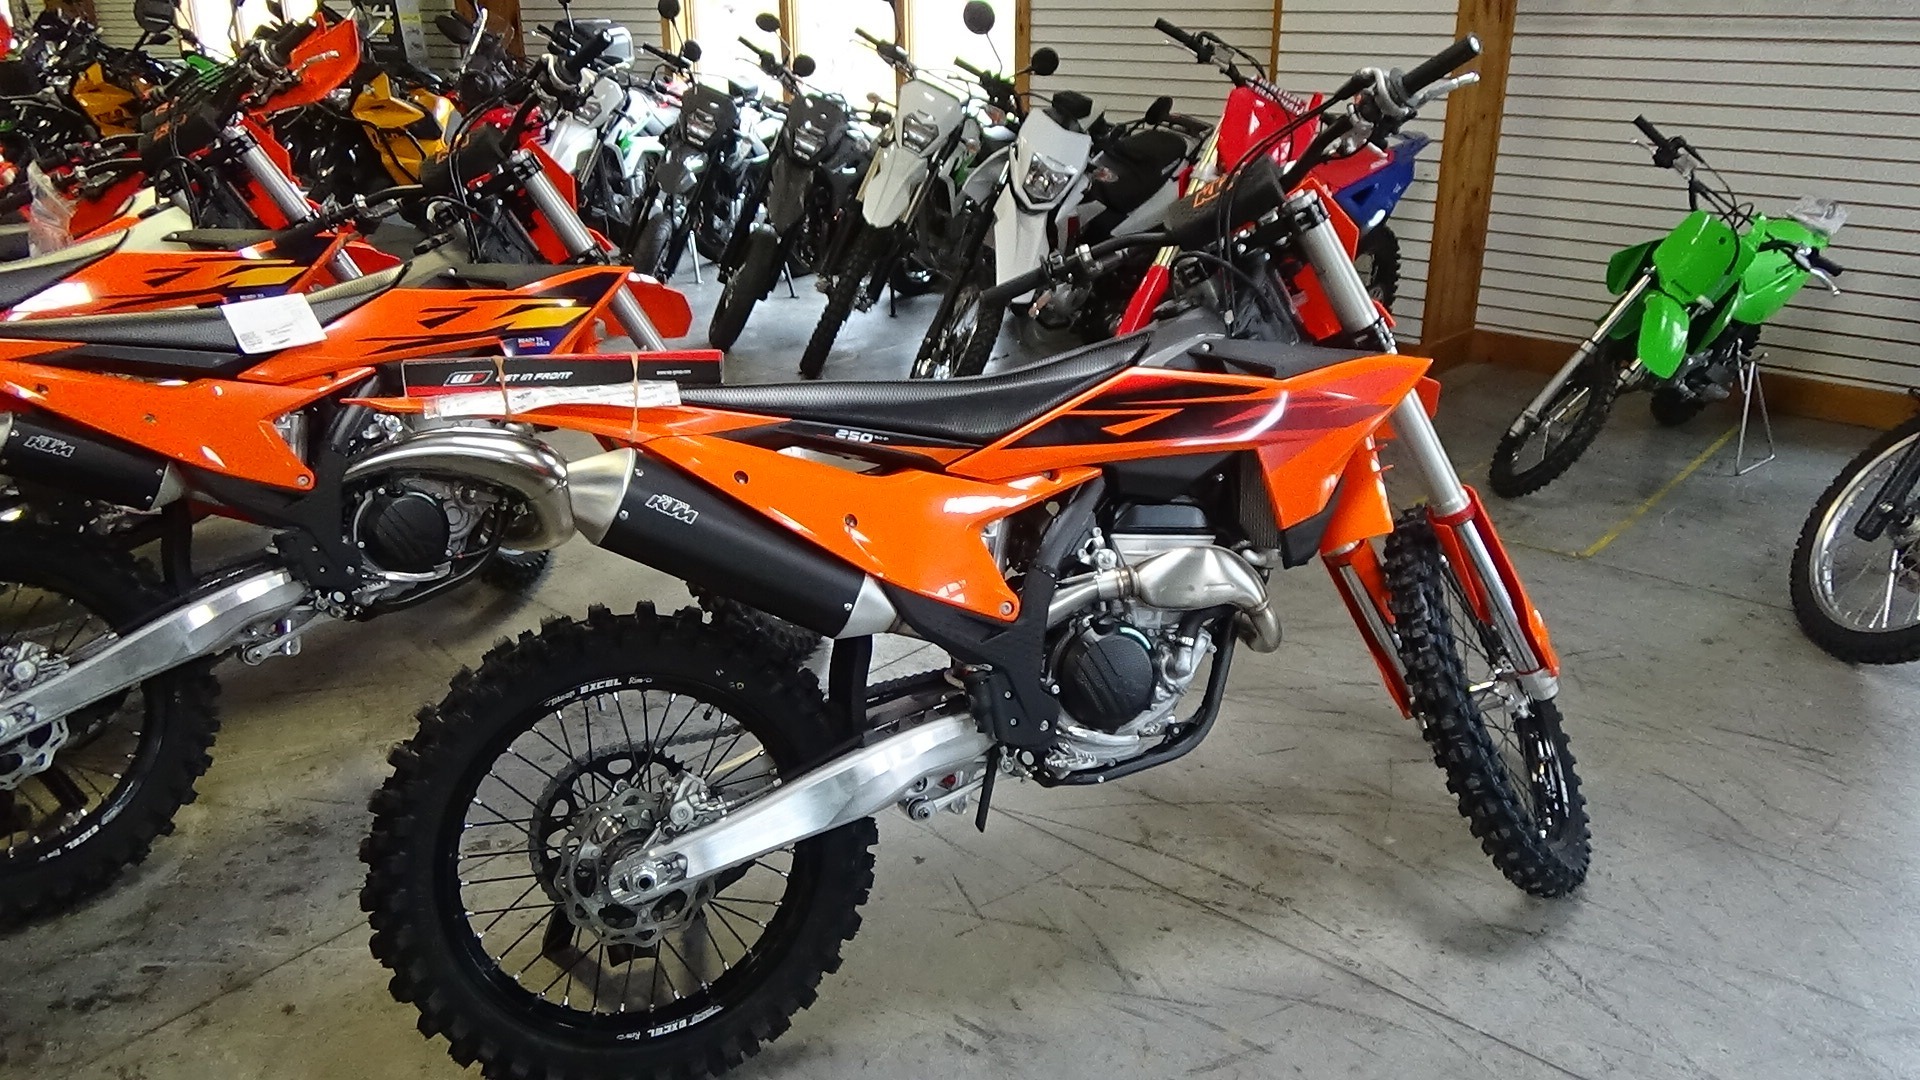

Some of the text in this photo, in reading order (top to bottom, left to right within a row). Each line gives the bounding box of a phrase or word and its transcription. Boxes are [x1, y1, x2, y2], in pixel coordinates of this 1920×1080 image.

[835, 428, 874, 443] 250
[23, 434, 76, 458] KTM
[644, 493, 700, 525] KTM
[580, 678, 622, 694] EXCEL
